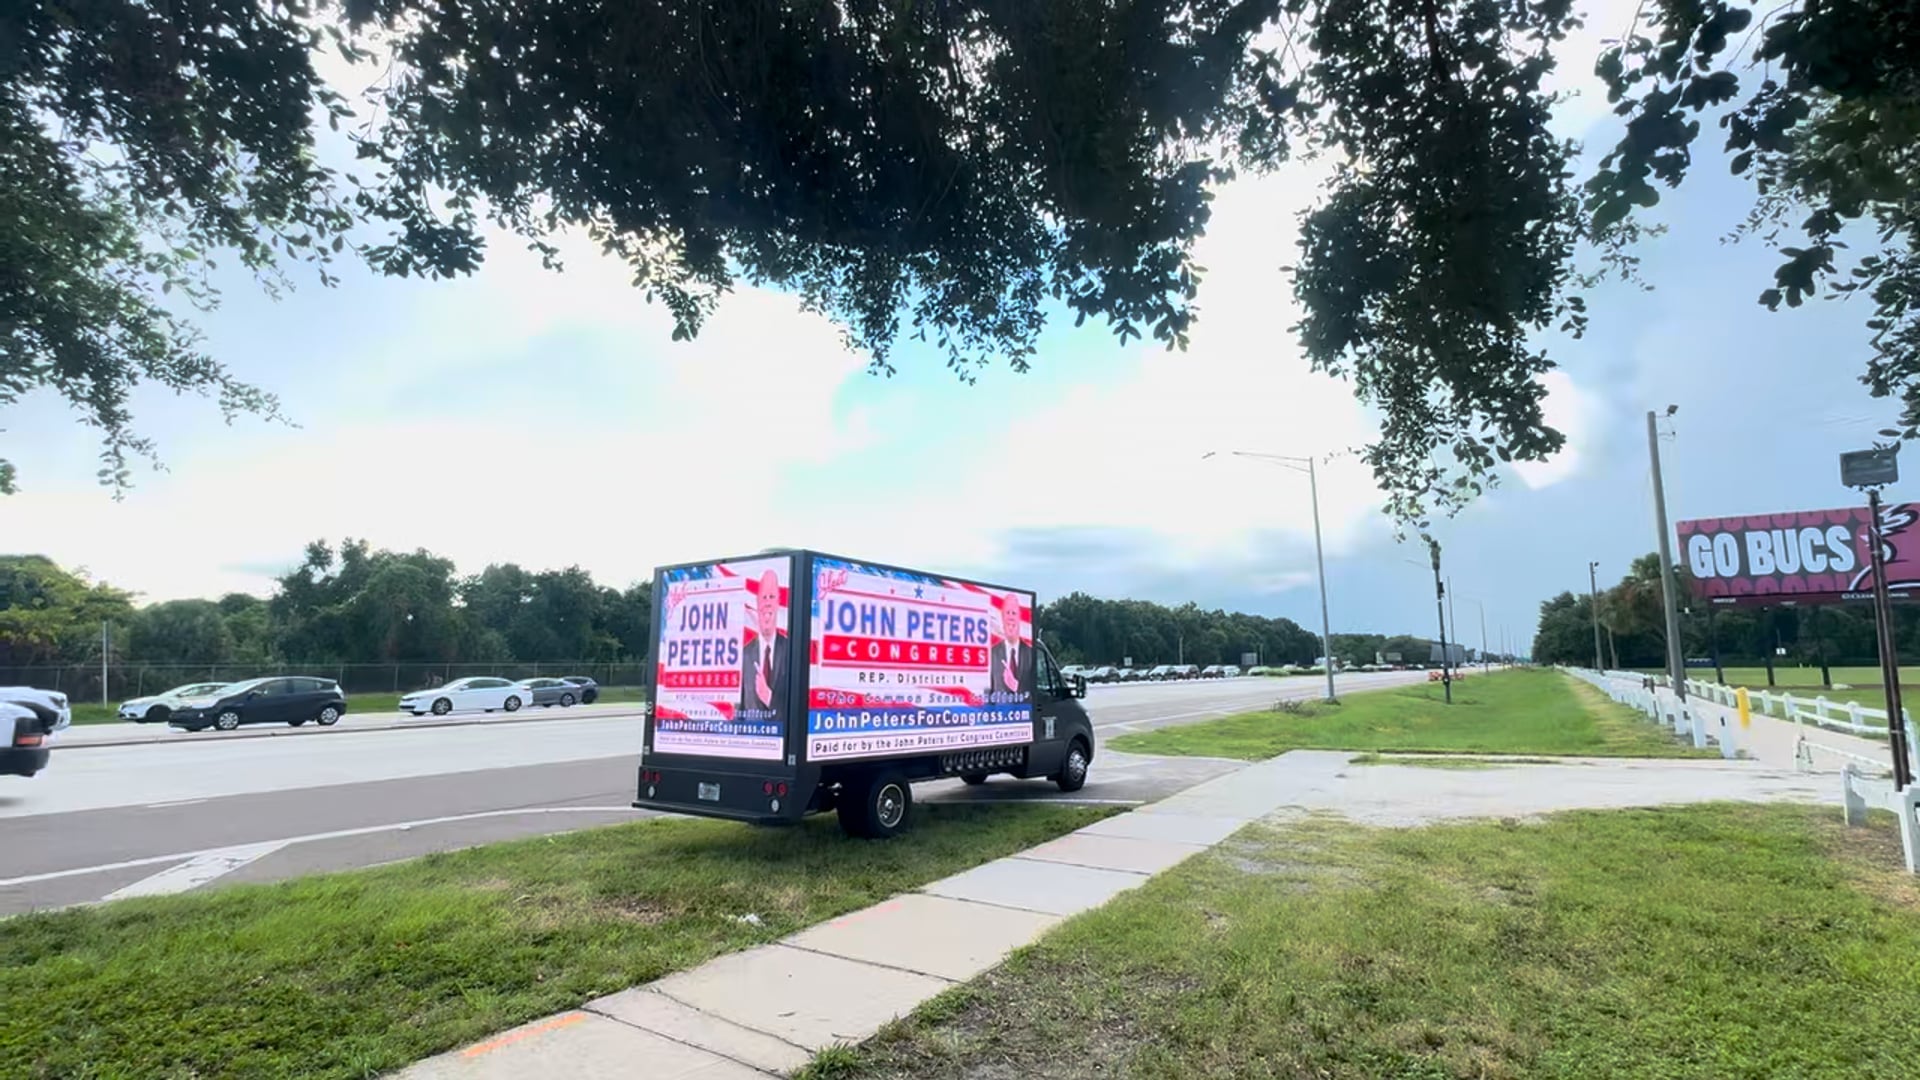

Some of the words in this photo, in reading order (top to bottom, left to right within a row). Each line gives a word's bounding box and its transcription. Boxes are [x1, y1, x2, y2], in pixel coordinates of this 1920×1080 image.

[1688, 532, 1740, 578] GO
[1745, 525, 1855, 576] BUCS
[681, 602, 728, 632] JOHN
[825, 600, 896, 637] JOHN
[907, 610, 988, 644] PETERS
[668, 638, 738, 666] PETERS
[847, 641, 986, 664] CONGRESS
[859, 672, 890, 683] REP.
[898, 673, 946, 684] District
[865, 692, 922, 704] Common
[814, 709, 1030, 730] JohnPetersForCongress.com
[815, 742, 839, 753] Paid
[843, 741, 857, 751] for
[861, 740, 872, 751] by
[876, 739, 891, 748] the
